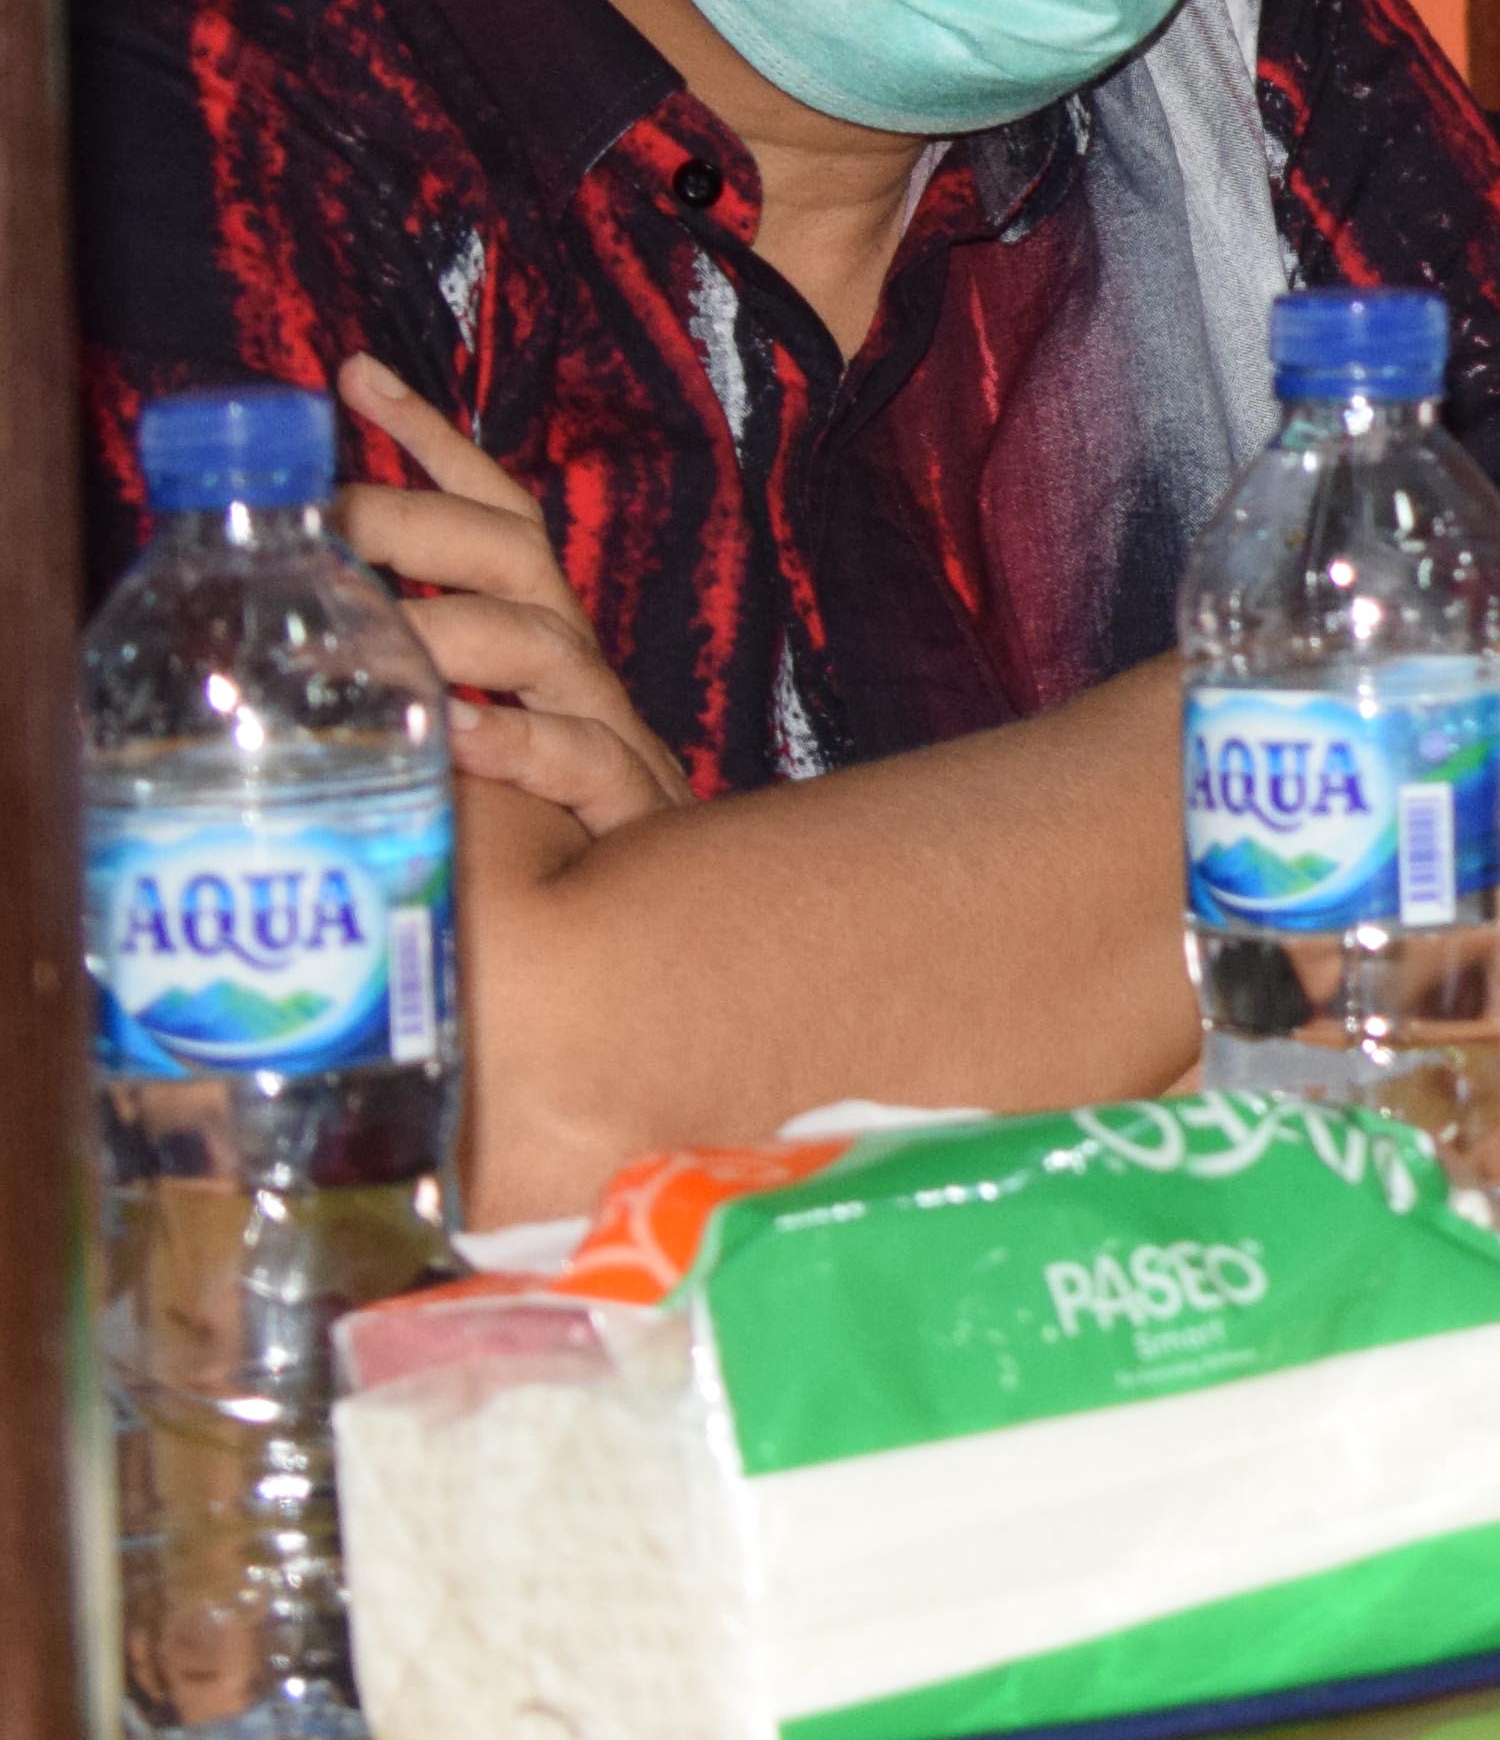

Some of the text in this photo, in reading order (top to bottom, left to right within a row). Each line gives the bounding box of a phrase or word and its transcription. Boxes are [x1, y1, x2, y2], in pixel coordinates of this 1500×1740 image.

[1187, 738, 1371, 833] AQUA
[121, 869, 367, 971] AQUA
[1044, 1241, 1268, 1338] PASEO
